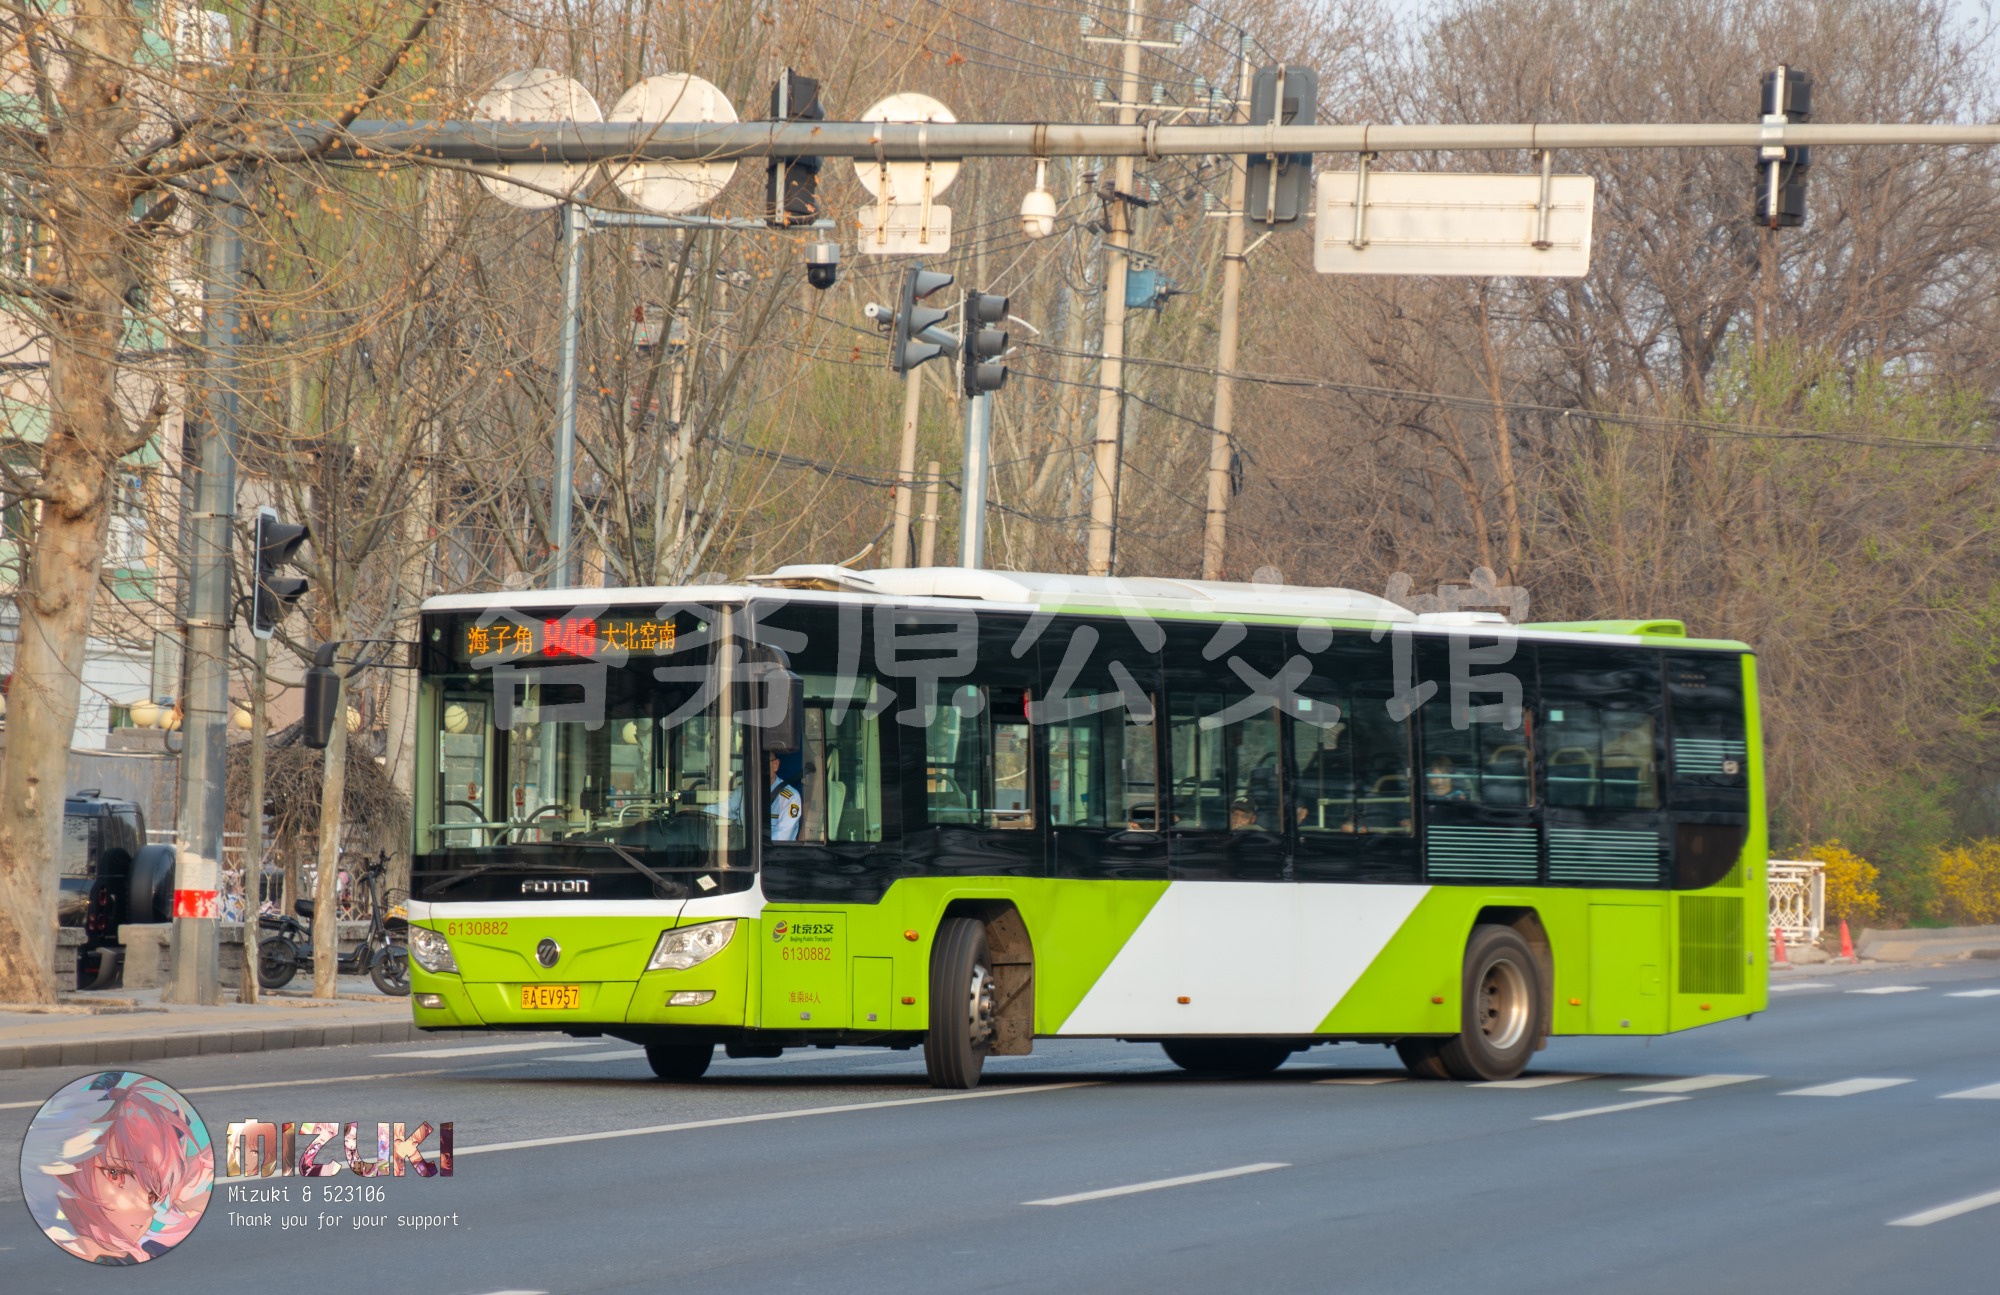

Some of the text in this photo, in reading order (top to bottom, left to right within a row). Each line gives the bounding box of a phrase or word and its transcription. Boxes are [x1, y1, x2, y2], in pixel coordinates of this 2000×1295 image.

[467, 617, 677, 658] 海子角 848 大北窑南
[521, 879, 590, 893] FOTON
[448, 921, 508, 936] 6130882
[791, 923, 834, 935] 北京公交
[782, 946, 831, 961] 6130882
